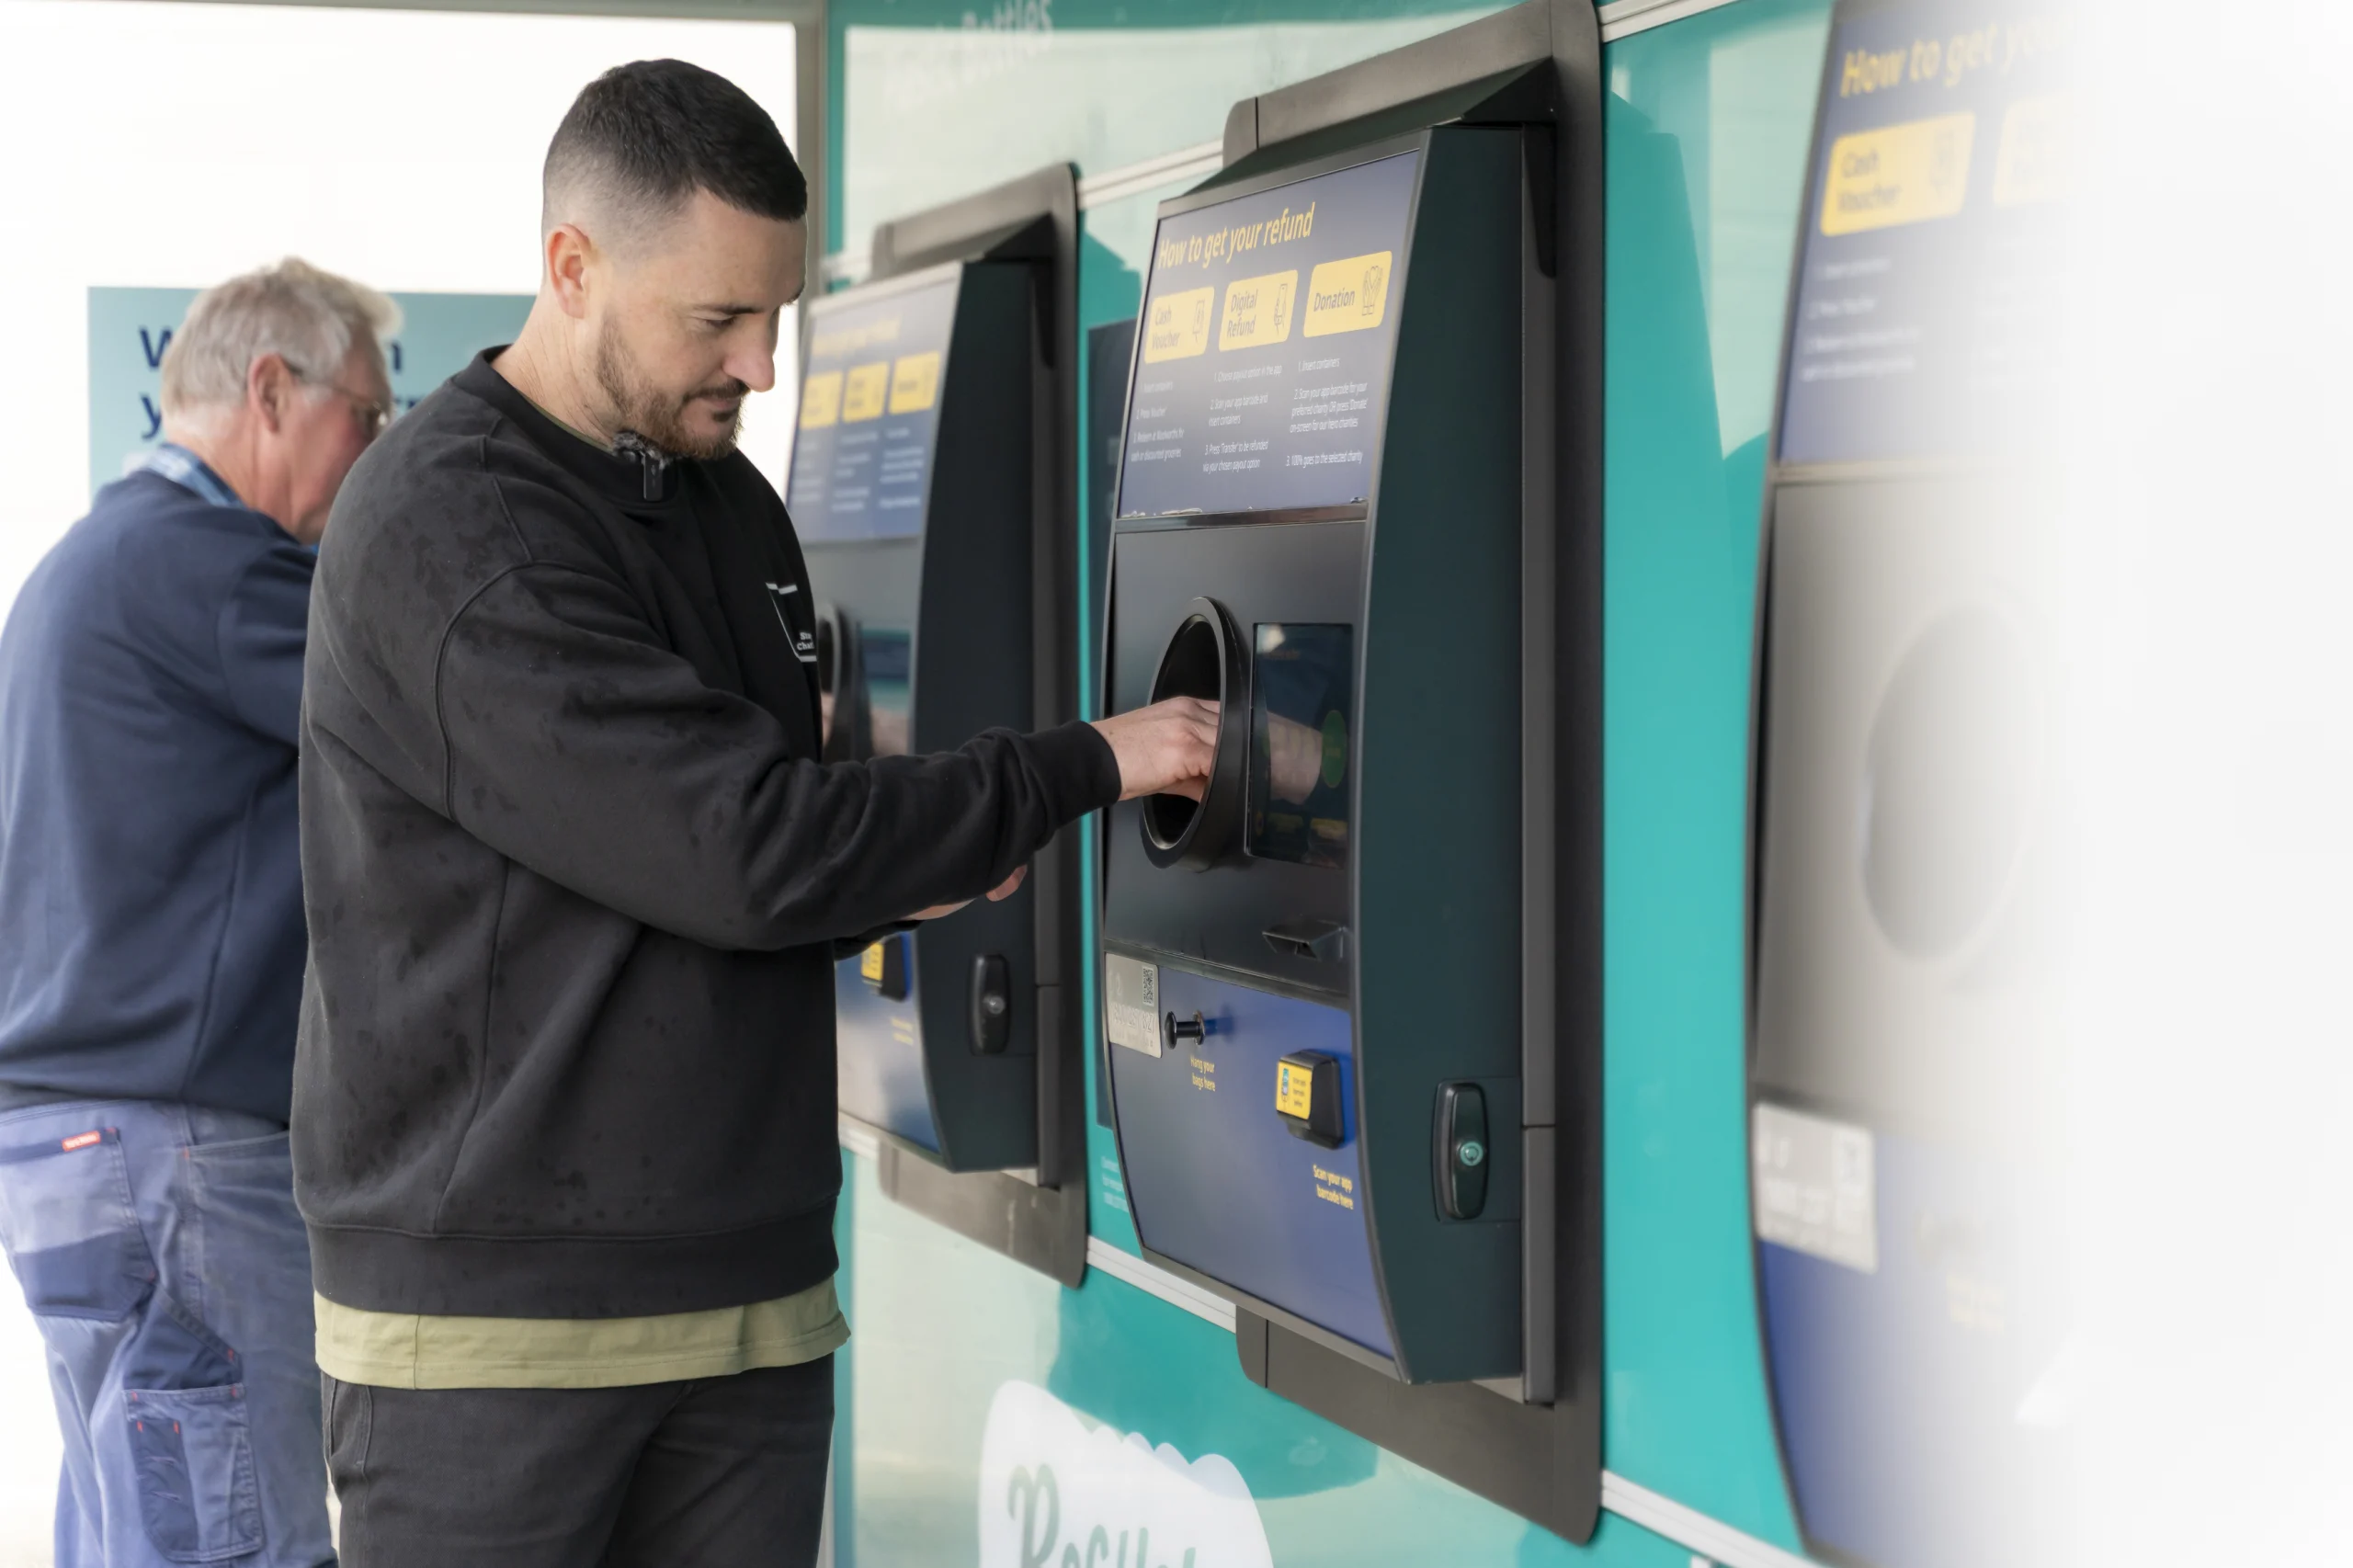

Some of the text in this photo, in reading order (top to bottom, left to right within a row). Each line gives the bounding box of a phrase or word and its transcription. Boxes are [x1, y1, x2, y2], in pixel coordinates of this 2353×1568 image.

[1158, 202, 1315, 269] How to get your refund
[1231, 290, 1258, 312] Digital
[1313, 287, 1356, 312] Donation
[1155, 308, 1172, 324] Cash
[1227, 316, 1256, 337] Refund
[1152, 330, 1181, 350] Voucher
[1298, 387, 1309, 399] Scan
[1209, 443, 1221, 455] Press
[1203, 1061, 1215, 1074] your
[1192, 1073, 1216, 1092] bags here
[1313, 1164, 1353, 1194] Scan your app
[1316, 1184, 1354, 1210] barcode here
